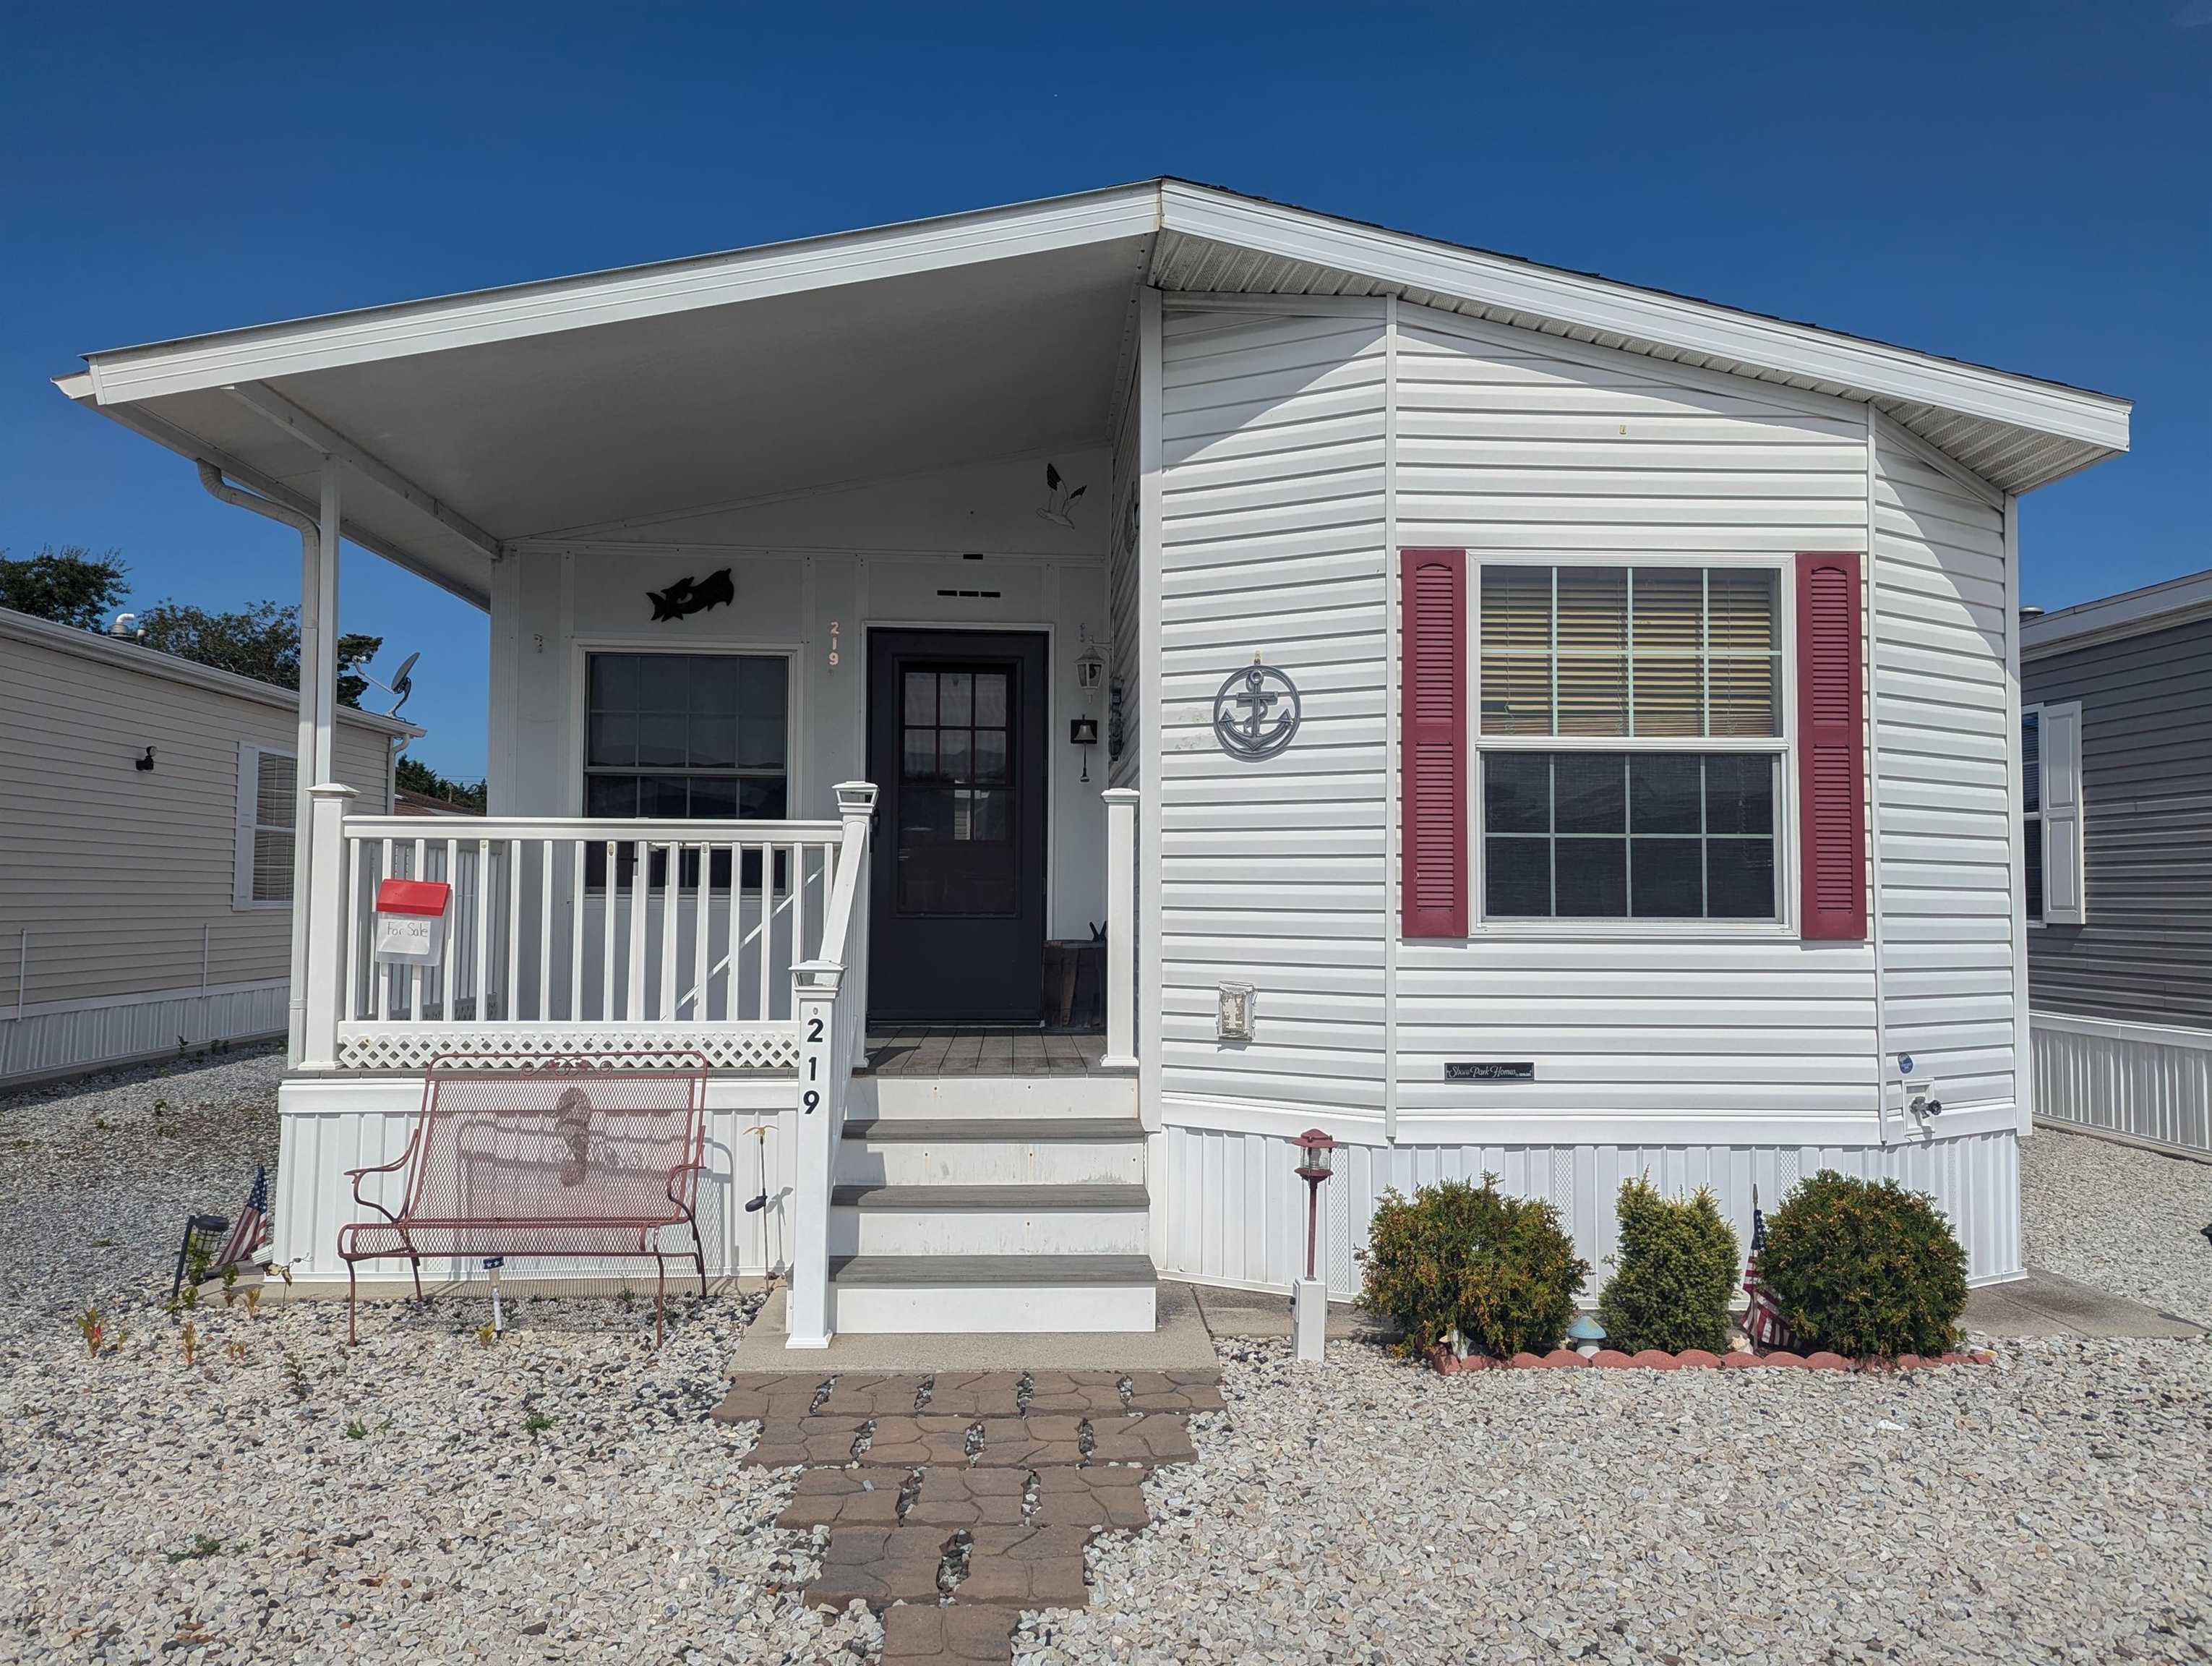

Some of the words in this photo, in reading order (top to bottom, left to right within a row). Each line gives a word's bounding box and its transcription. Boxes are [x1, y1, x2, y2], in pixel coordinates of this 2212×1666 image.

[828, 621, 839, 666] 219
[387, 921, 403, 936] For
[407, 922, 428, 938] Sale
[803, 1018, 824, 1115] 219
[1470, 1066, 1489, 1078] Park
